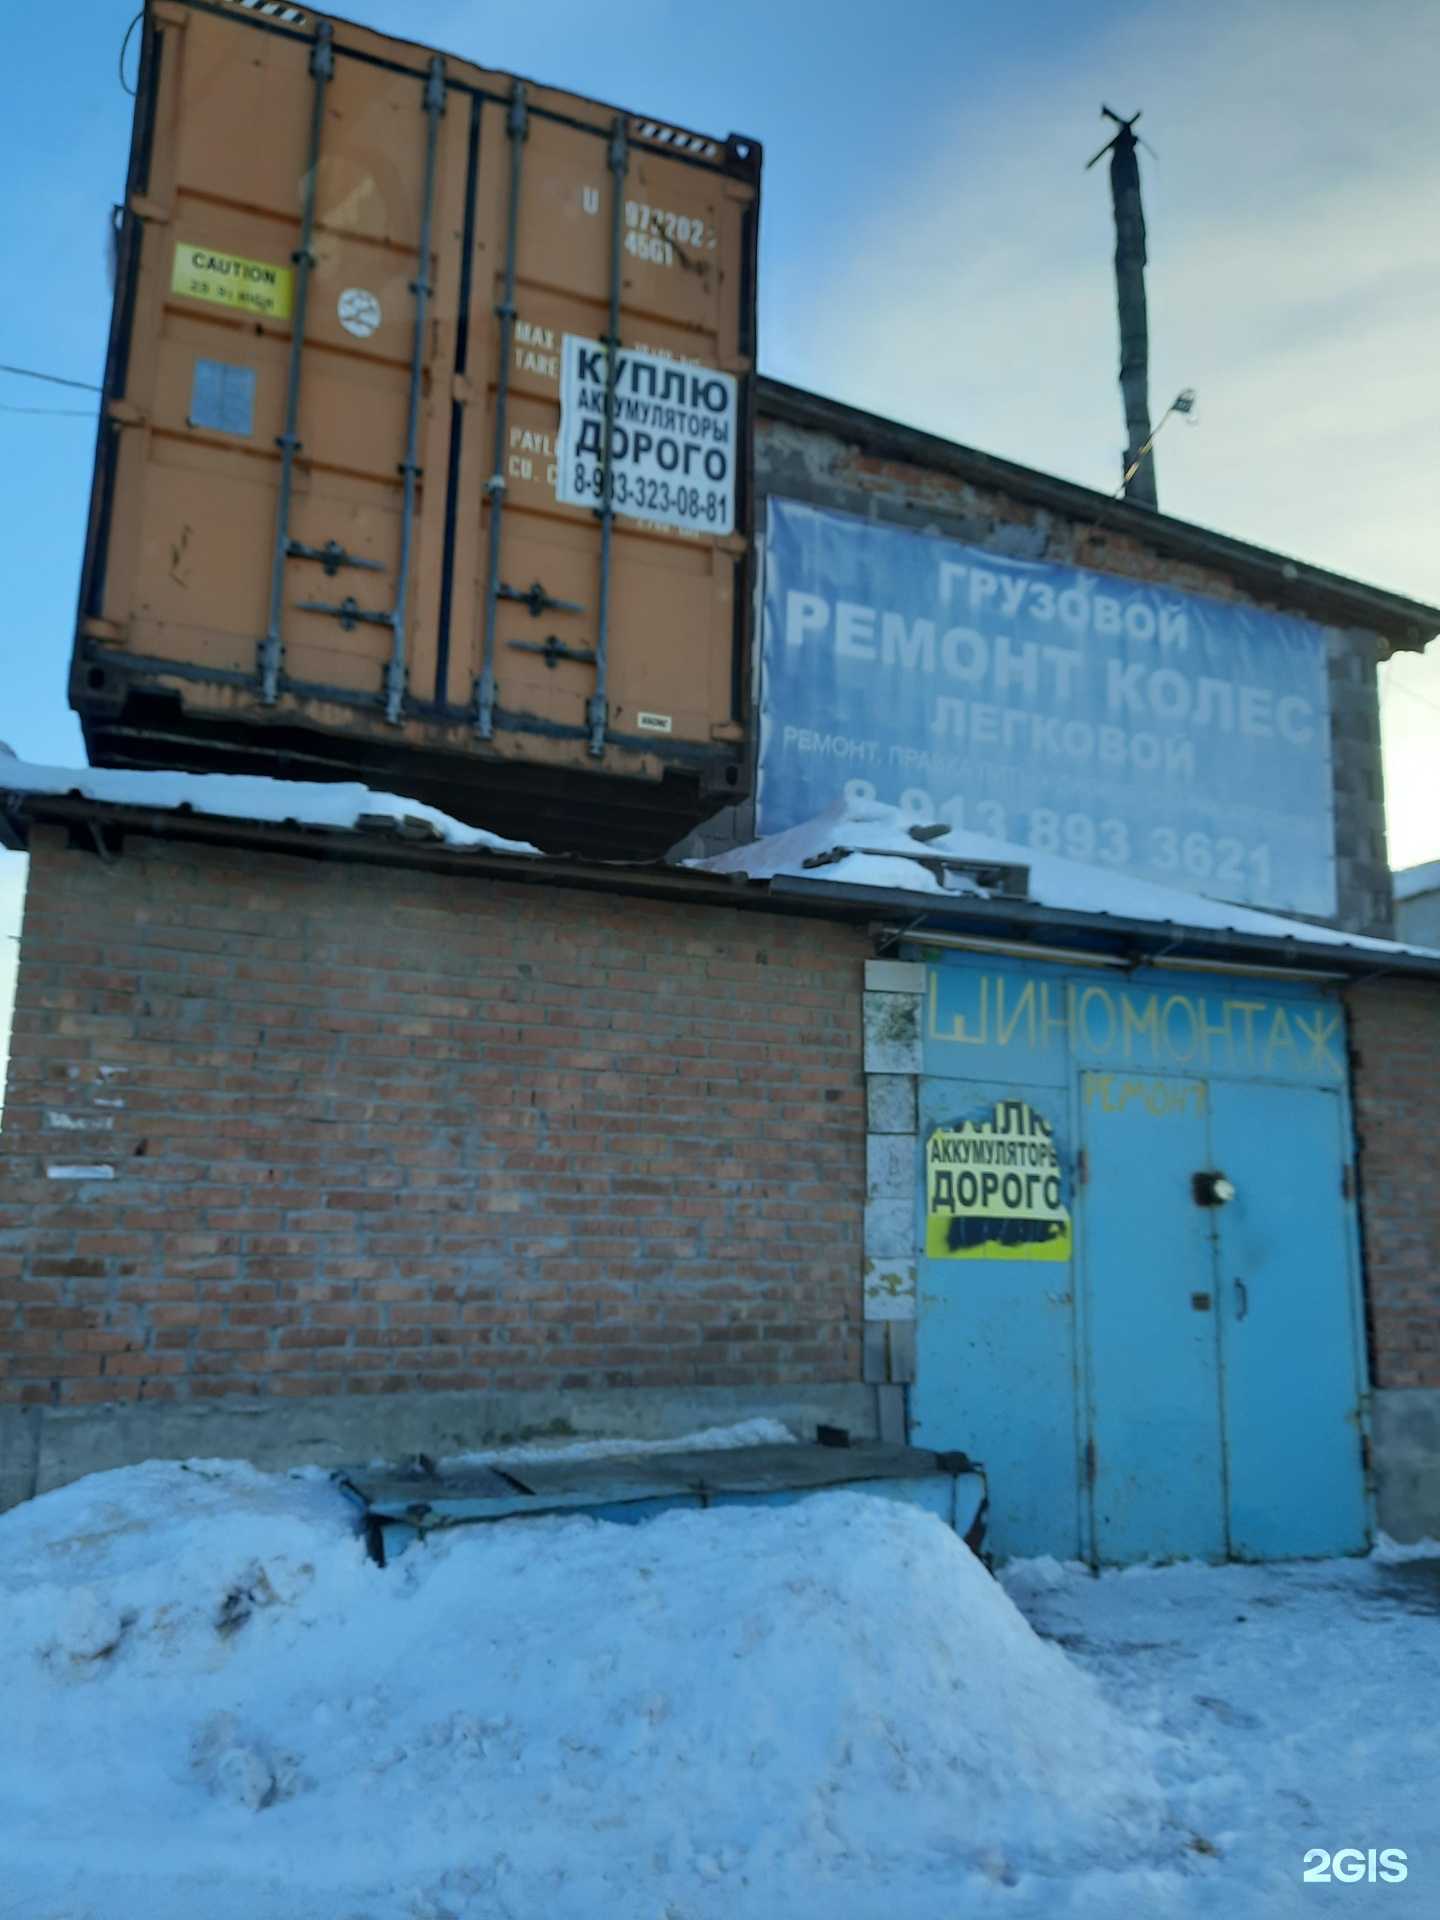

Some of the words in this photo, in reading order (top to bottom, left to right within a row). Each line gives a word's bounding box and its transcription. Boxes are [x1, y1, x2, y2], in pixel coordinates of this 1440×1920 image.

[582, 185, 600, 216] U
[191, 251, 277, 285] CAUTION
[578, 348, 728, 413] КУПЛЮ
[575, 418, 727, 482] ДОРОГО
[573, 462, 727, 524] 8-93-323-08-81
[938, 561, 1188, 649] ГРУЗОВОЙ
[786, 590, 1084, 698] РЕМОНТ
[1107, 657, 1315, 745] КОЛЕС
[931, 696, 1195, 773] ЛЕГКОВОЙ
[1028, 808, 1130, 864] 893
[1151, 827, 1272, 886] 3621
[928, 970, 1343, 1077] ШИНОМОНТАЖ
[931, 1170, 1061, 1213] ДОРОГО
